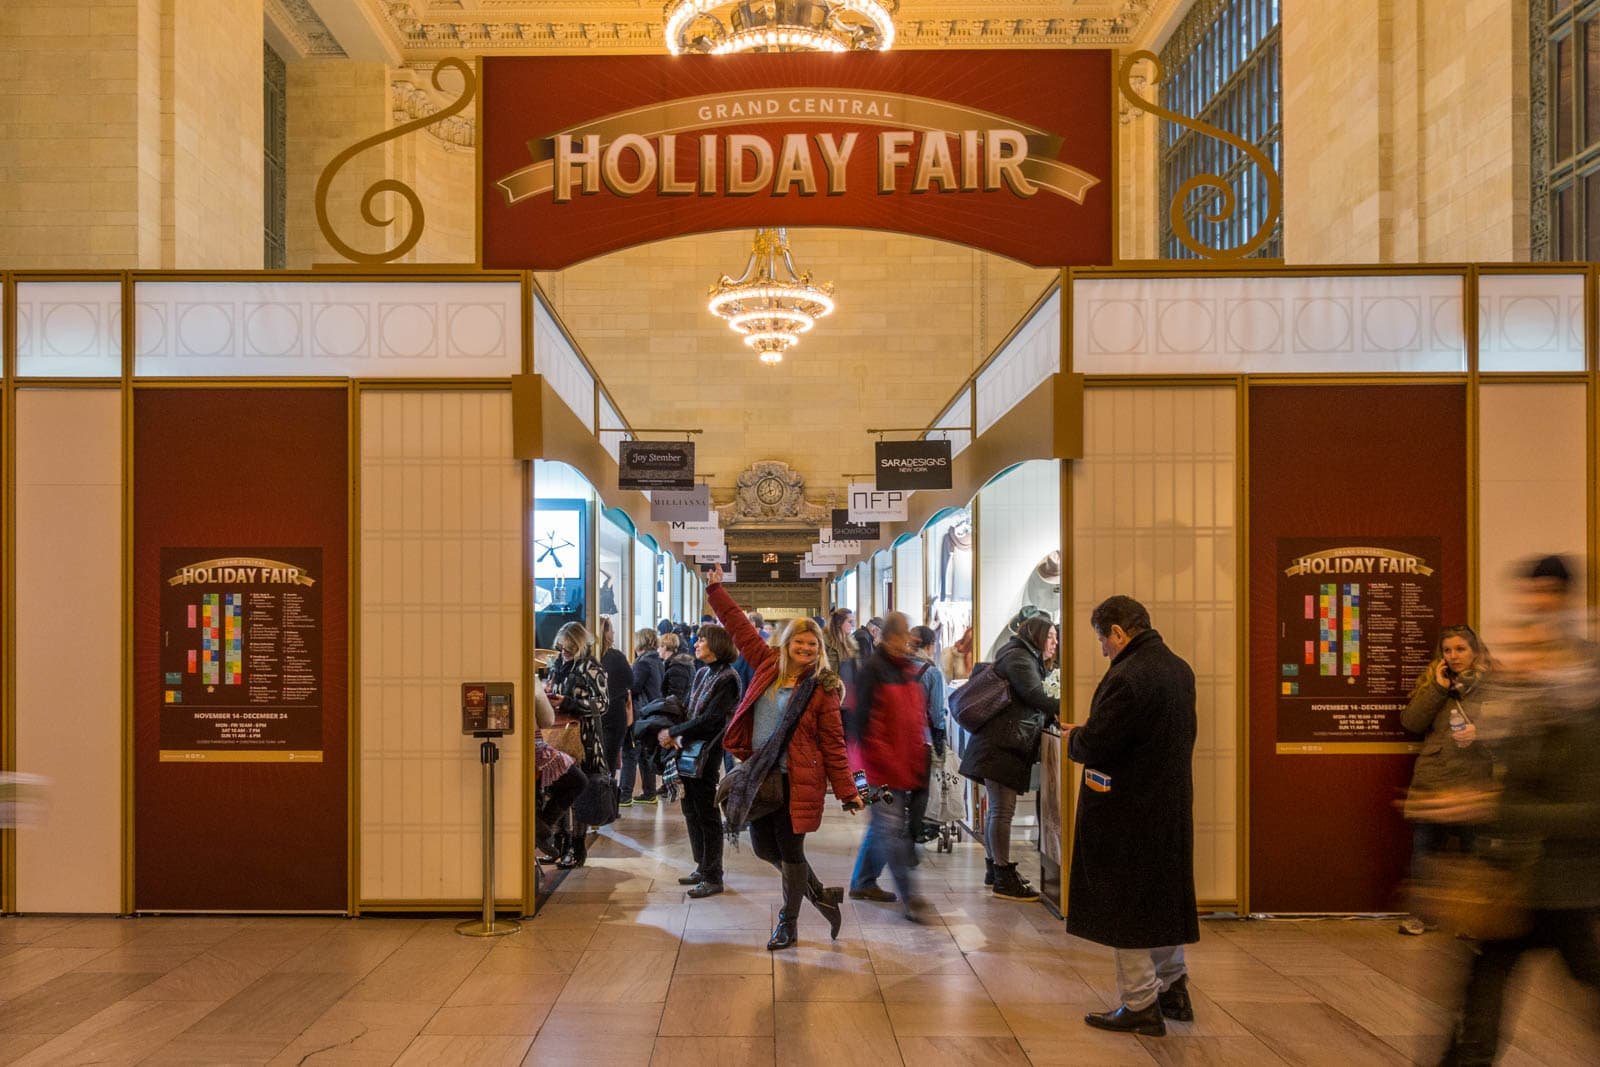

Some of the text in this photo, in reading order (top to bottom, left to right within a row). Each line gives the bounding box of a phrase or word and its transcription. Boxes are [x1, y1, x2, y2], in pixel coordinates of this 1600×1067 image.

[698, 97, 893, 121] GRAND CENTRAL
[553, 129, 1039, 204] HOLIDAY FAIR
[632, 452, 682, 464] Joy Stember
[1300, 557, 1421, 576] HOLIDAY FAIR
[182, 568, 302, 585] HOLIDAY FAIR
